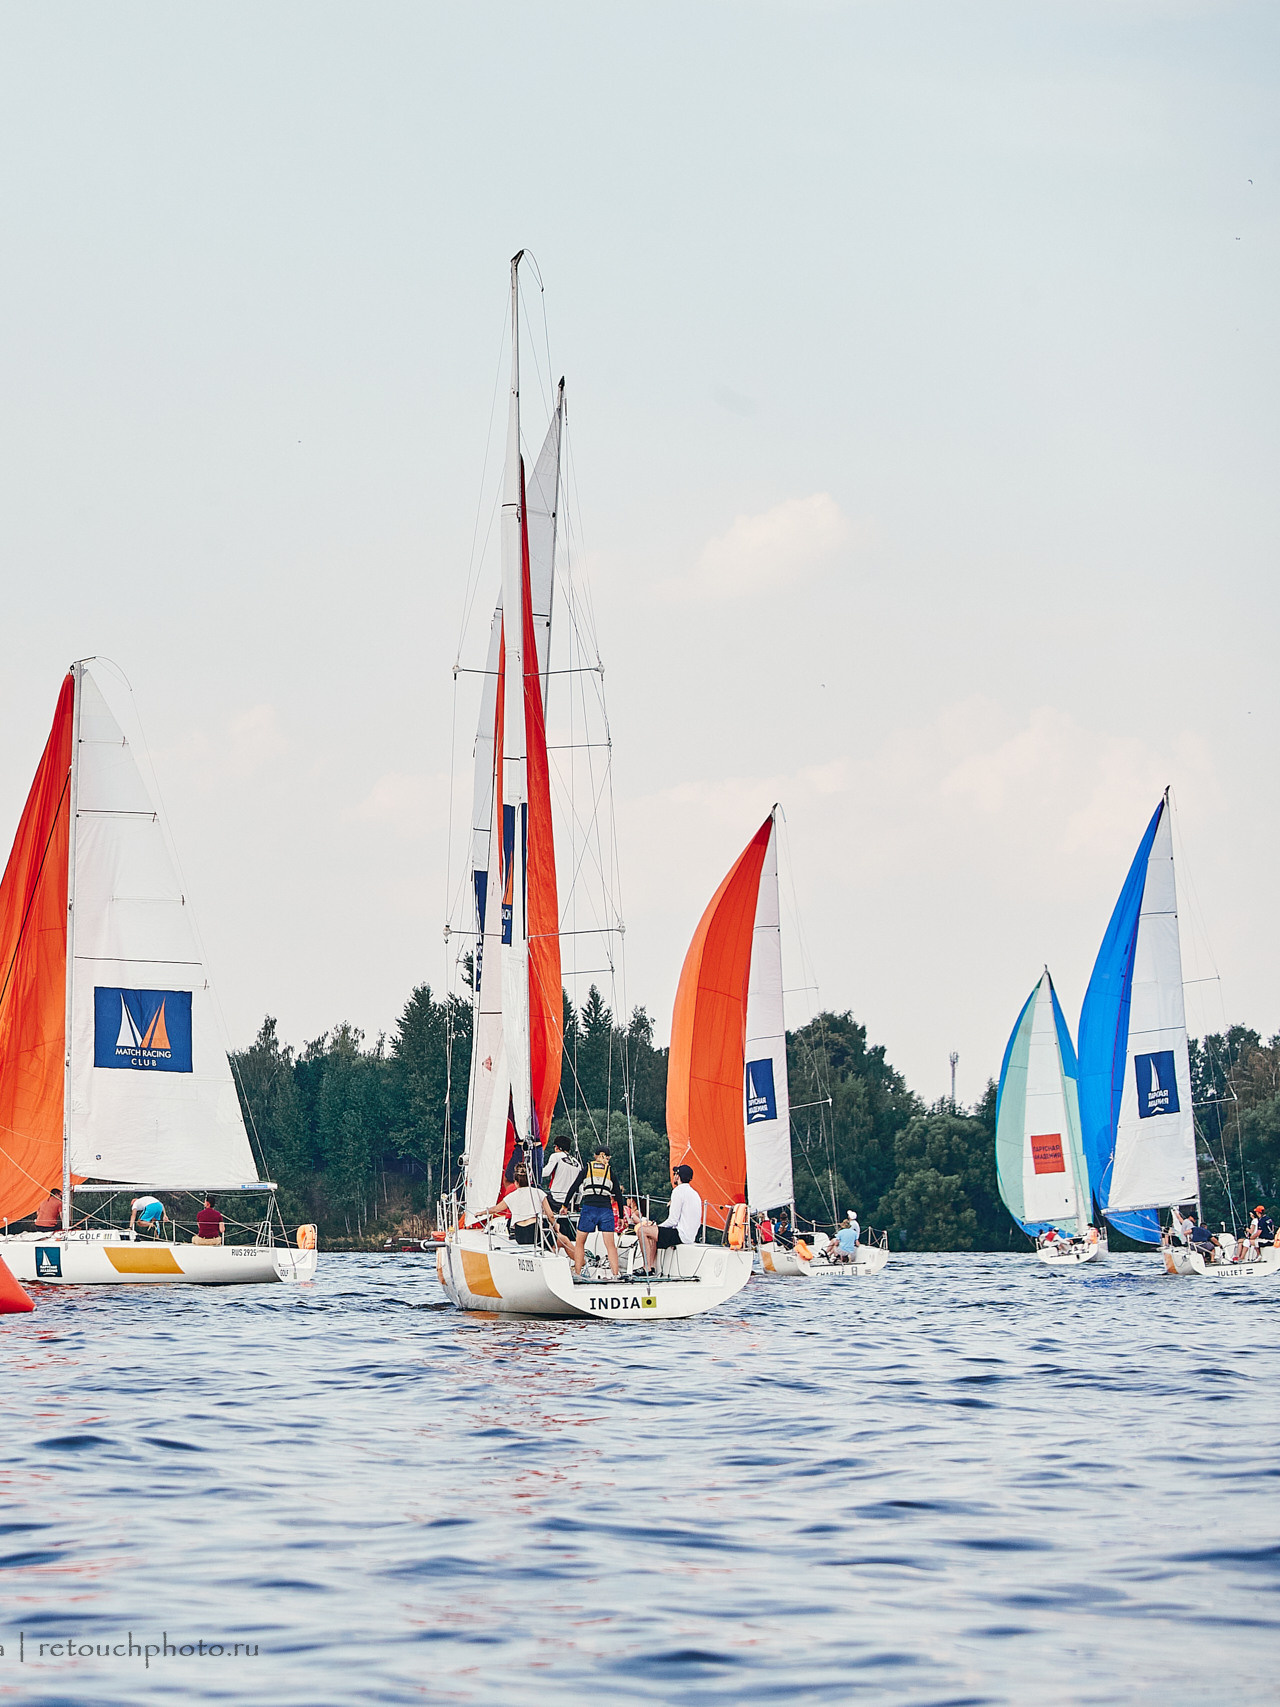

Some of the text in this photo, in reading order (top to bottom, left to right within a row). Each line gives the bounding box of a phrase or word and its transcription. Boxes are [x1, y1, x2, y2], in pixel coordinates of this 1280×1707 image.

[115, 1048, 171, 1059] MATCH RACING
[131, 1058, 157, 1066] CLUB
[589, 1297, 640, 1310] INDIA
